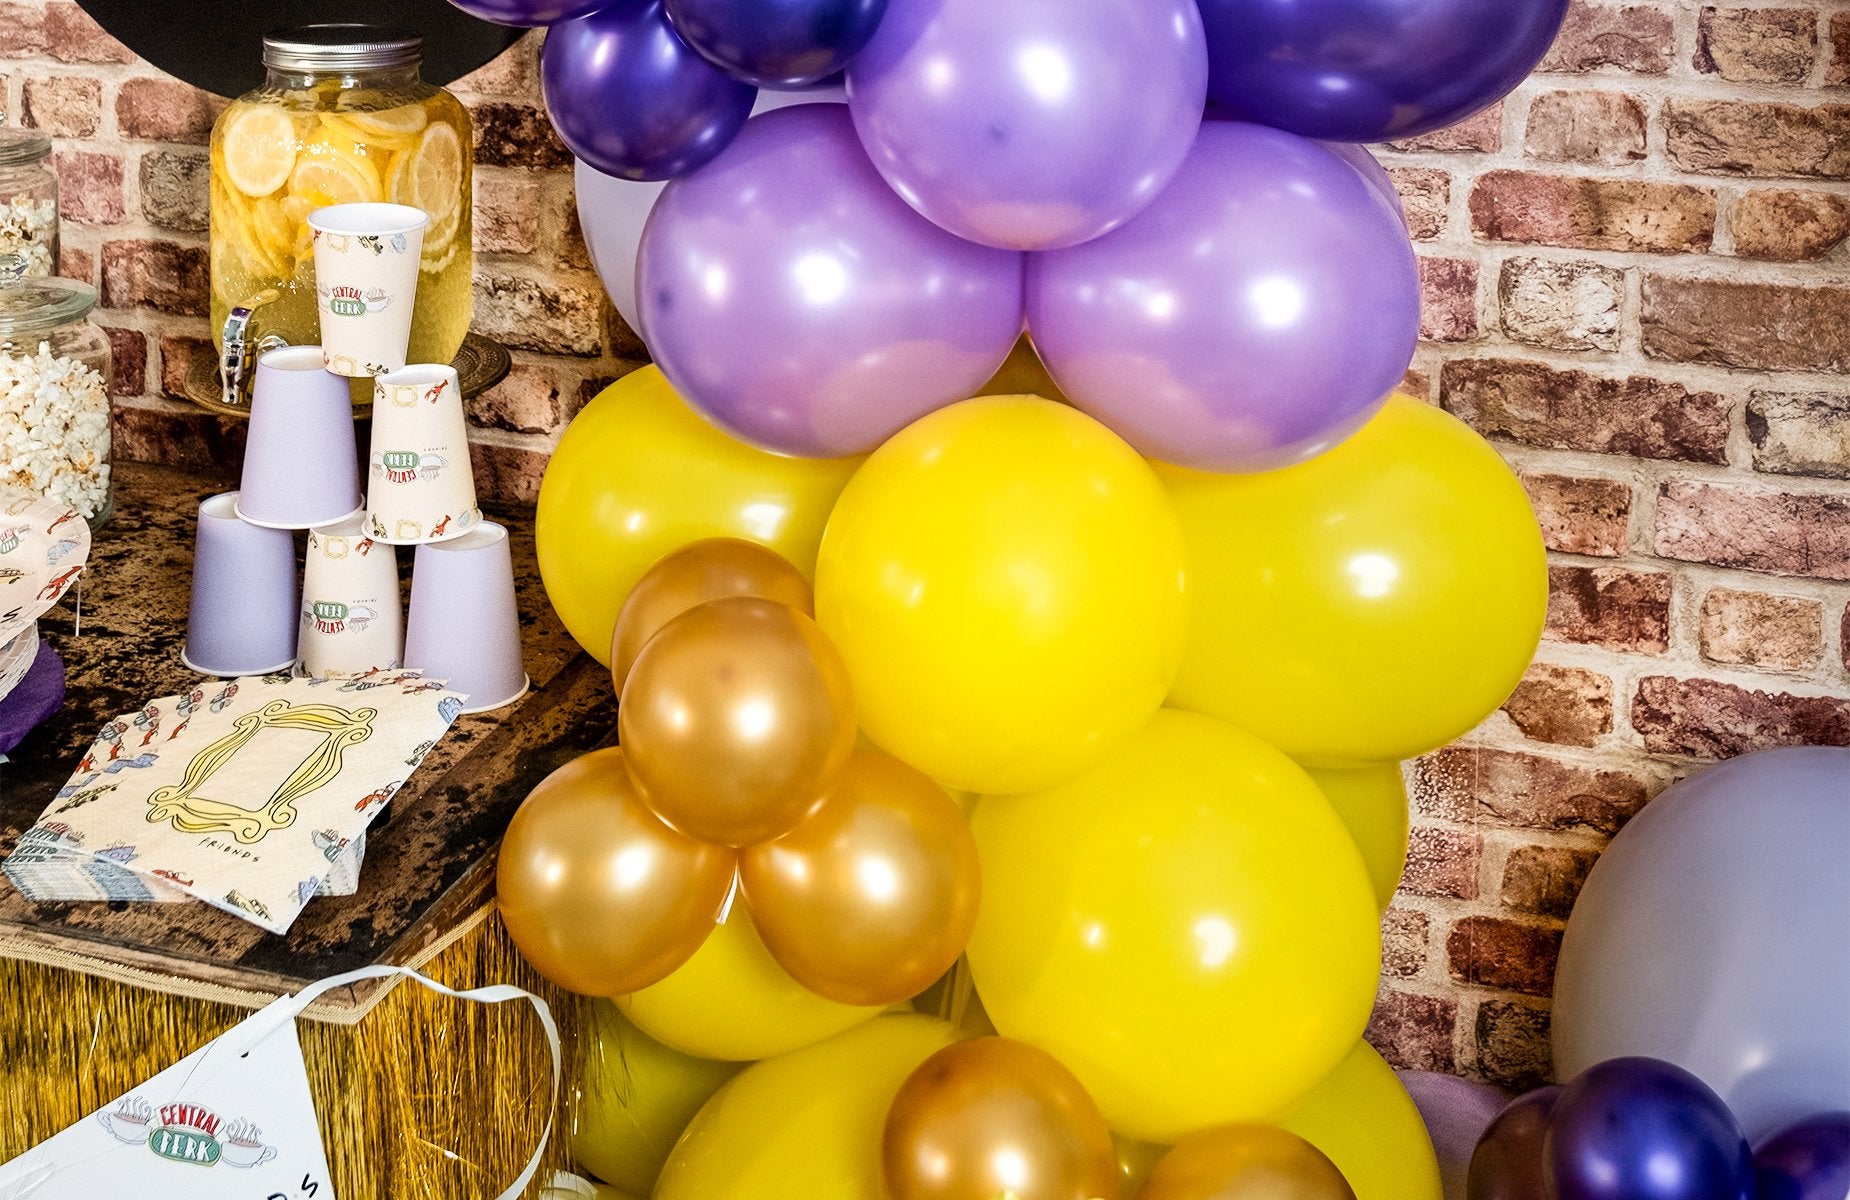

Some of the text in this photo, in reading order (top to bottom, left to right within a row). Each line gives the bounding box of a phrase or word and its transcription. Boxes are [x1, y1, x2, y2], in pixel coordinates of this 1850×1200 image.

[331, 285, 363, 300] CENTRAL
[159, 1103, 222, 1137] CENTRAL
[159, 1129, 215, 1163] PERK
